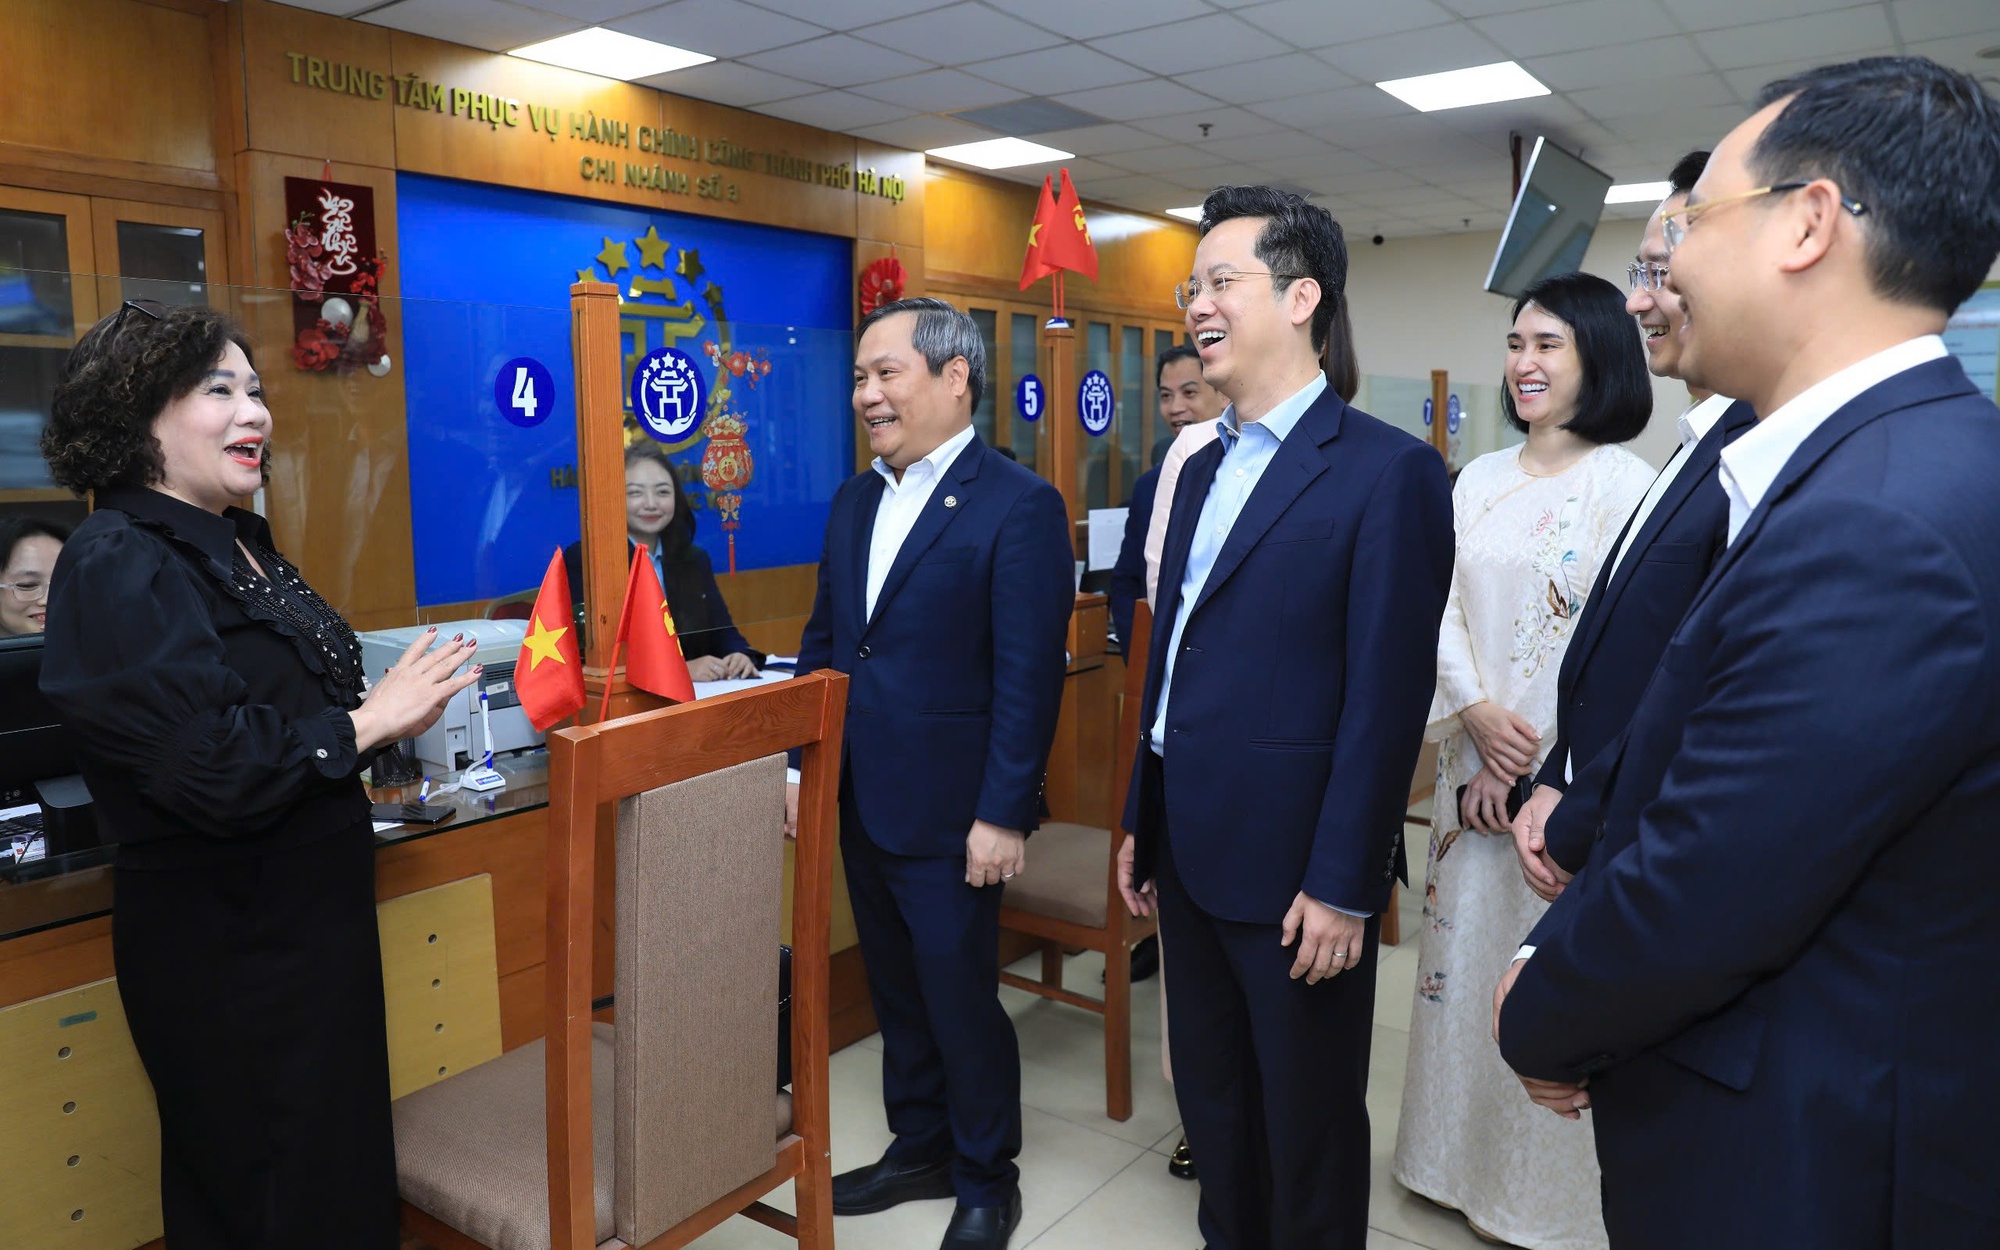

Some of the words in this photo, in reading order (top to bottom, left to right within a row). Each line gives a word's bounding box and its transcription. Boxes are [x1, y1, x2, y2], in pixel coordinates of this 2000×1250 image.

[287, 52, 388, 100] TRUNG
[393, 73, 445, 114] TÂM
[451, 87, 521, 130] PHỤC
[527, 104, 561, 141] VỤ
[568, 110, 629, 149] HÀNH
[637, 126, 698, 160] CHÍNH
[704, 137, 753, 171] CÔNG
[817, 161, 852, 188] PHỐ
[855, 167, 877, 195] HÀ
[881, 172, 906, 205] NỘI
[580, 156, 616, 185] CHI
[623, 164, 689, 195] NHÁNH
[696, 173, 721, 200] SỐ
[511, 367, 538, 417] 4
[1024, 381, 1038, 416] 5
